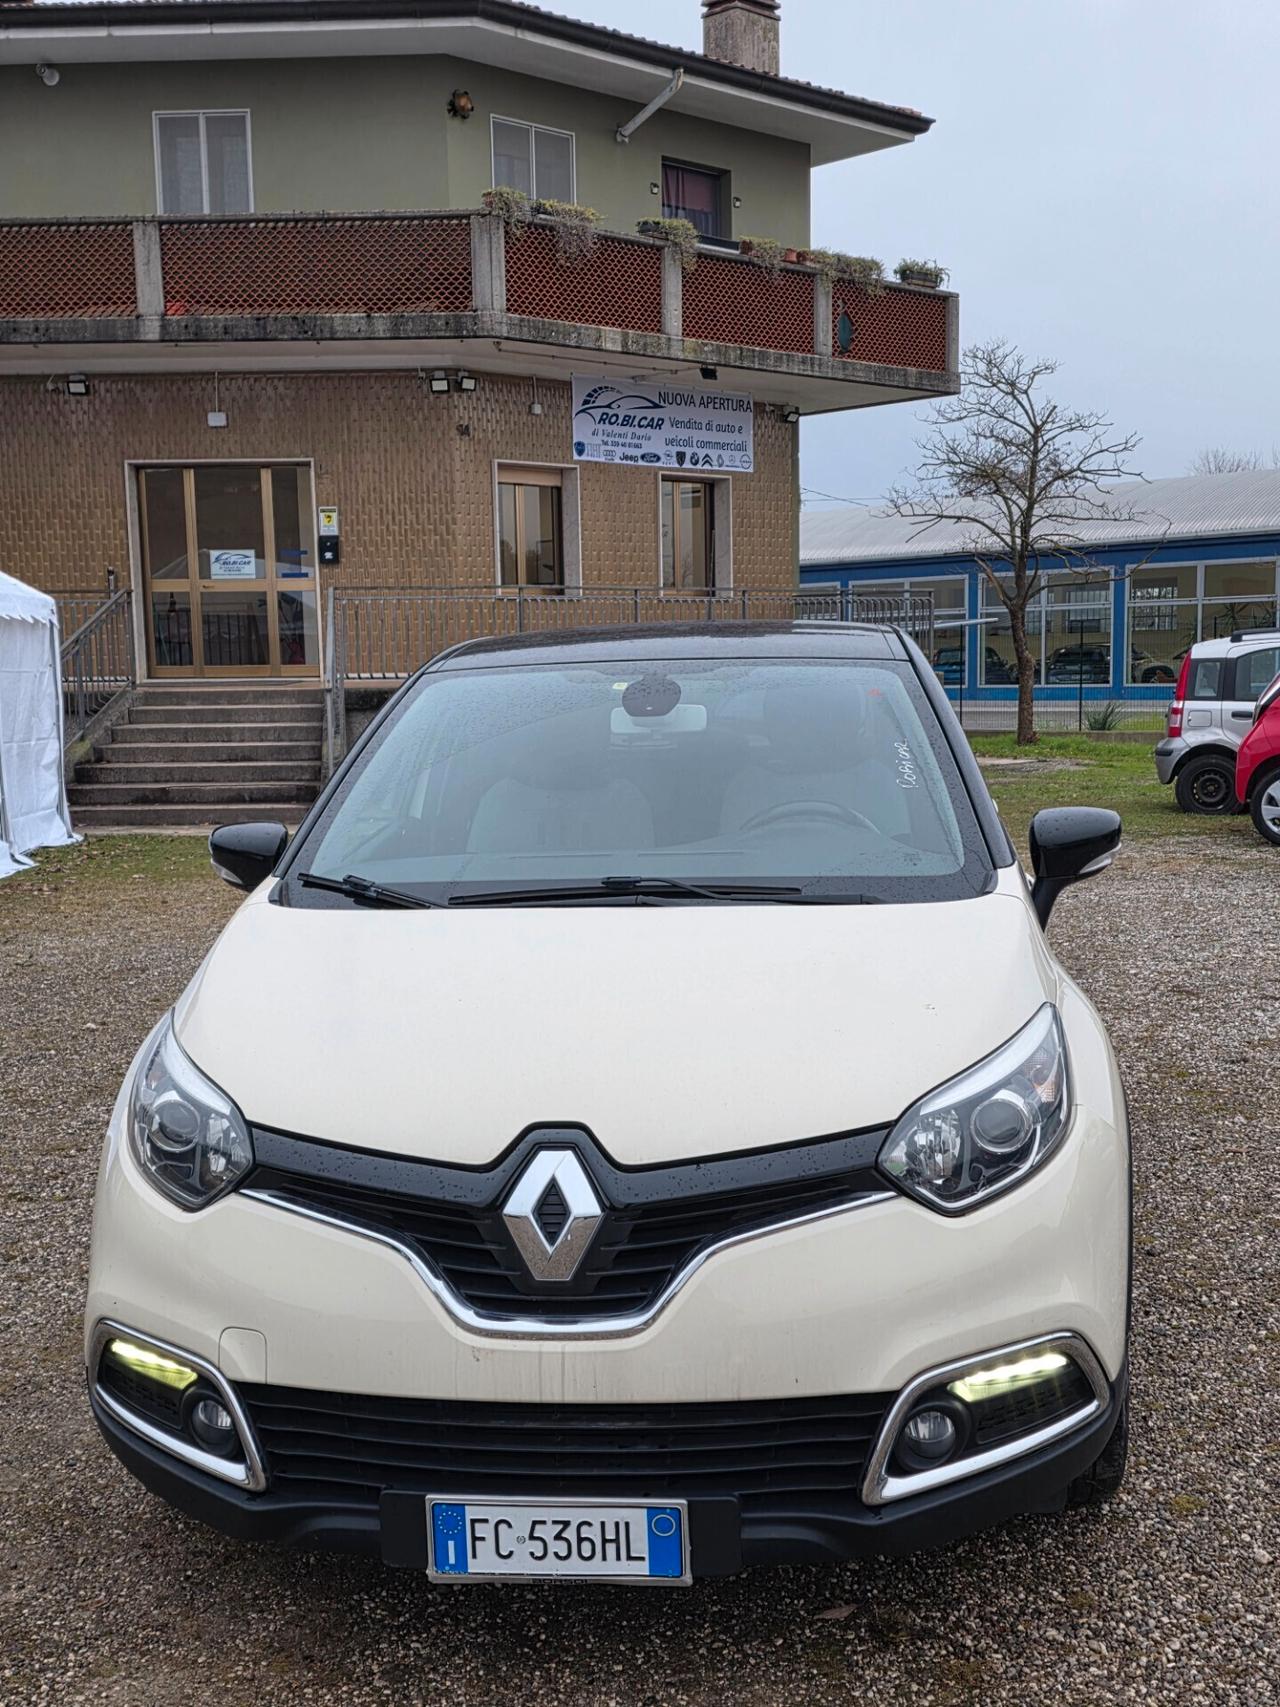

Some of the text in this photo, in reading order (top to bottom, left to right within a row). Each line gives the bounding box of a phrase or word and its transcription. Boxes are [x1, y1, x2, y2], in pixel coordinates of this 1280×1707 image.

[658, 391, 752, 413] NUOVA APERTURA
[597, 412, 665, 431] RO.BI.CAR
[669, 416, 743, 434] Vendita di auto e
[591, 428, 652, 441] di Valenti Dario
[665, 436, 747, 452] veicoli commerciali
[619, 452, 639, 463] Jeep
[469, 1517, 646, 1562] FC 536HL
